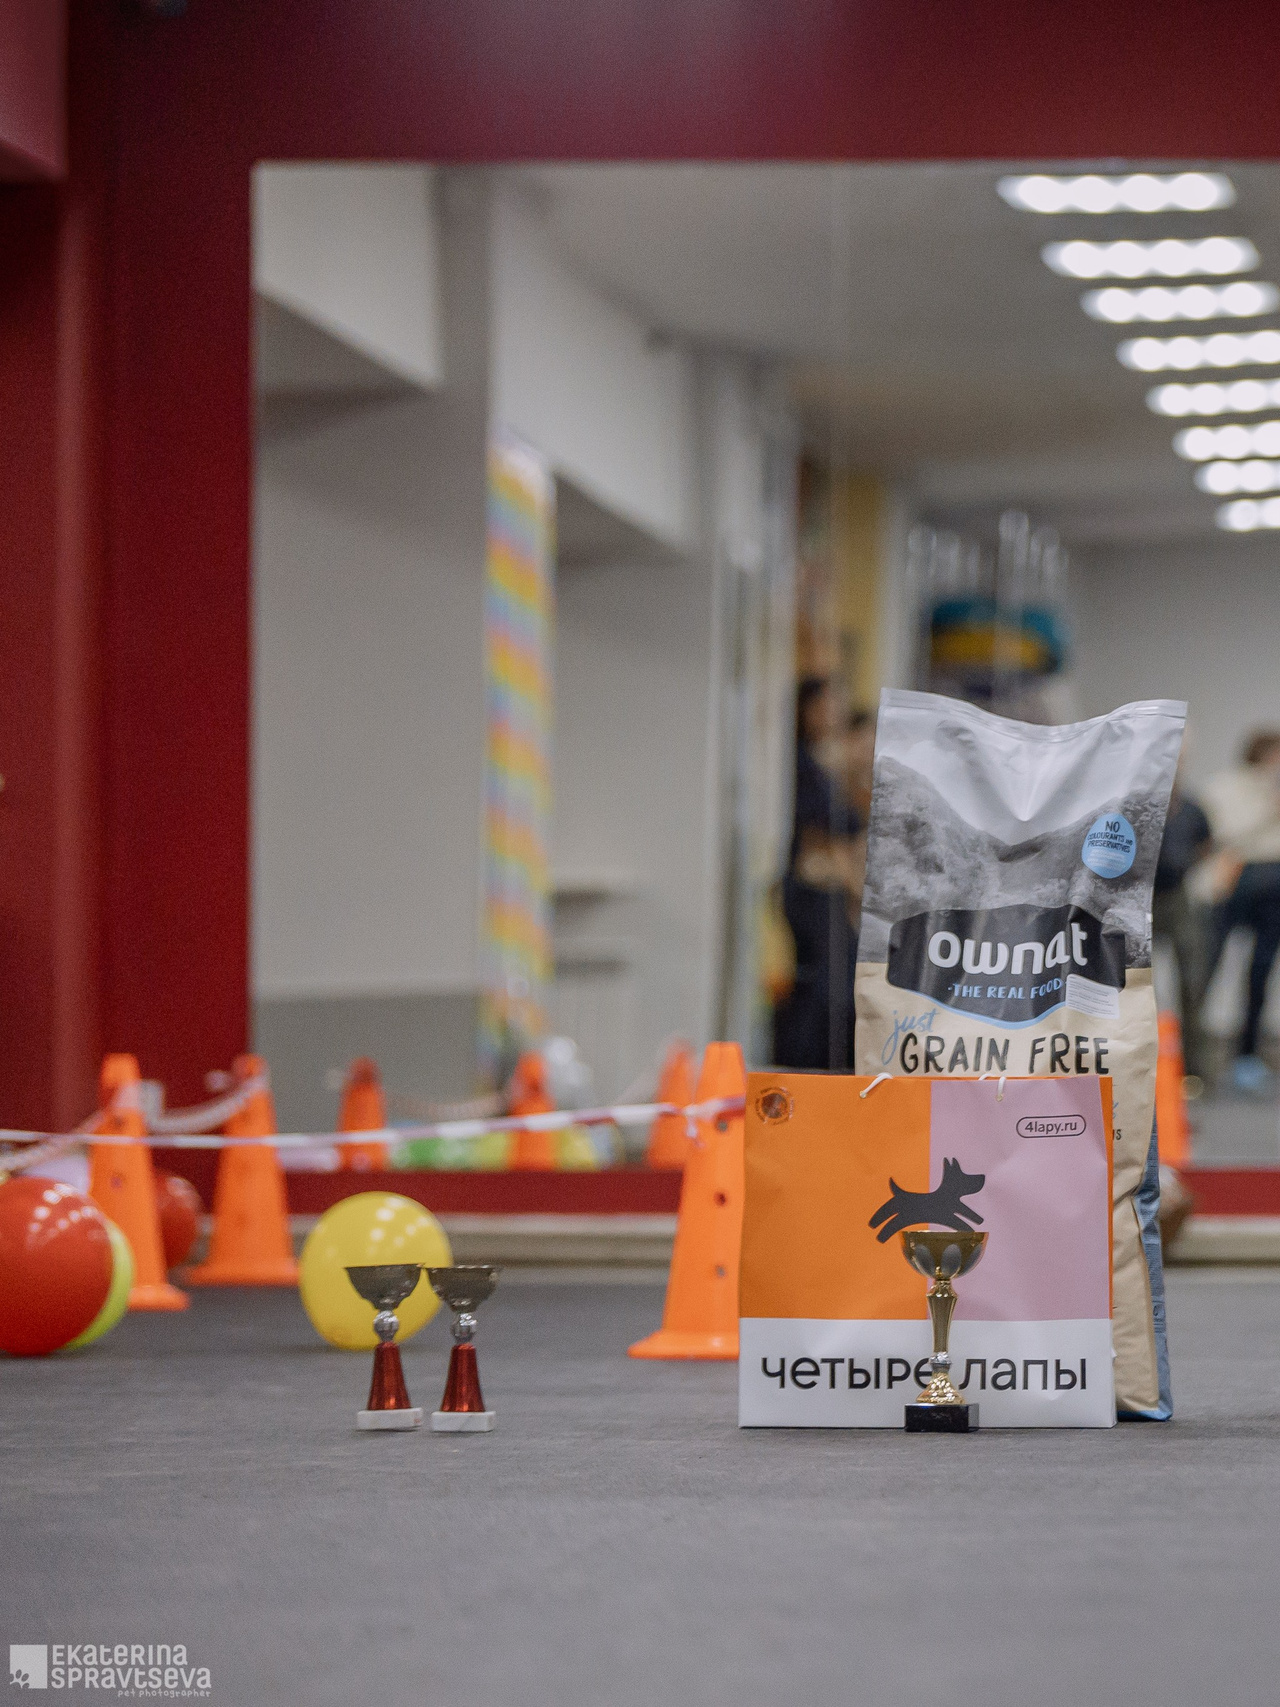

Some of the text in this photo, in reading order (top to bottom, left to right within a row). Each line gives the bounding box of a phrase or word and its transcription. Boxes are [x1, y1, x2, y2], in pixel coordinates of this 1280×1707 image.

[1087, 832, 1125, 842] COLOURANTS
[1105, 821, 1120, 833] NO
[1087, 840, 1131, 853] PRESERVATIVES
[928, 922, 1089, 975] ownat
[952, 977, 1062, 999] THE REAL FOOD
[881, 1008, 940, 1066] just
[900, 1032, 1109, 1075] GRAIN FREE
[1024, 1121, 1077, 1135] 4lapy.ru
[958, 1357, 1087, 1391] лапы
